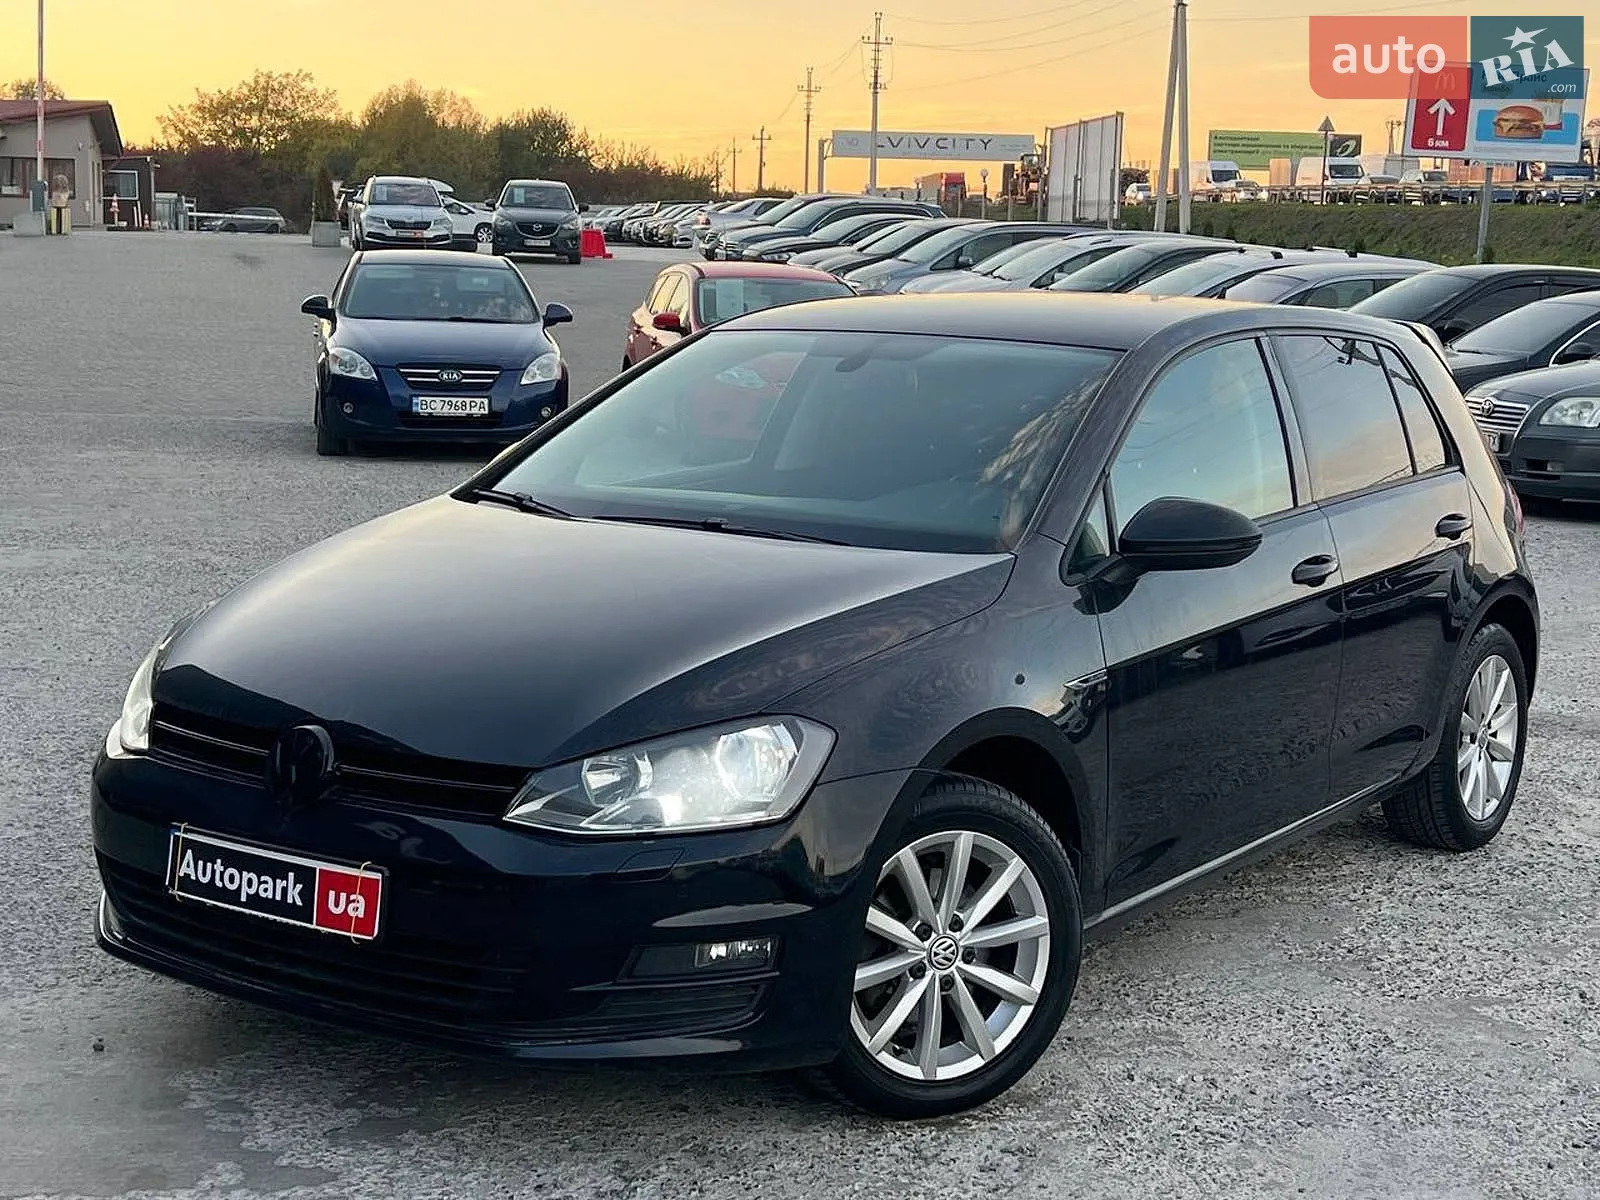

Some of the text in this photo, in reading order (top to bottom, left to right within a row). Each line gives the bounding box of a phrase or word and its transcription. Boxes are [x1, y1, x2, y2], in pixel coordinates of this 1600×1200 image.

[420, 399, 486, 411] BC 7968 PA
[178, 849, 365, 918] Autopark ua
